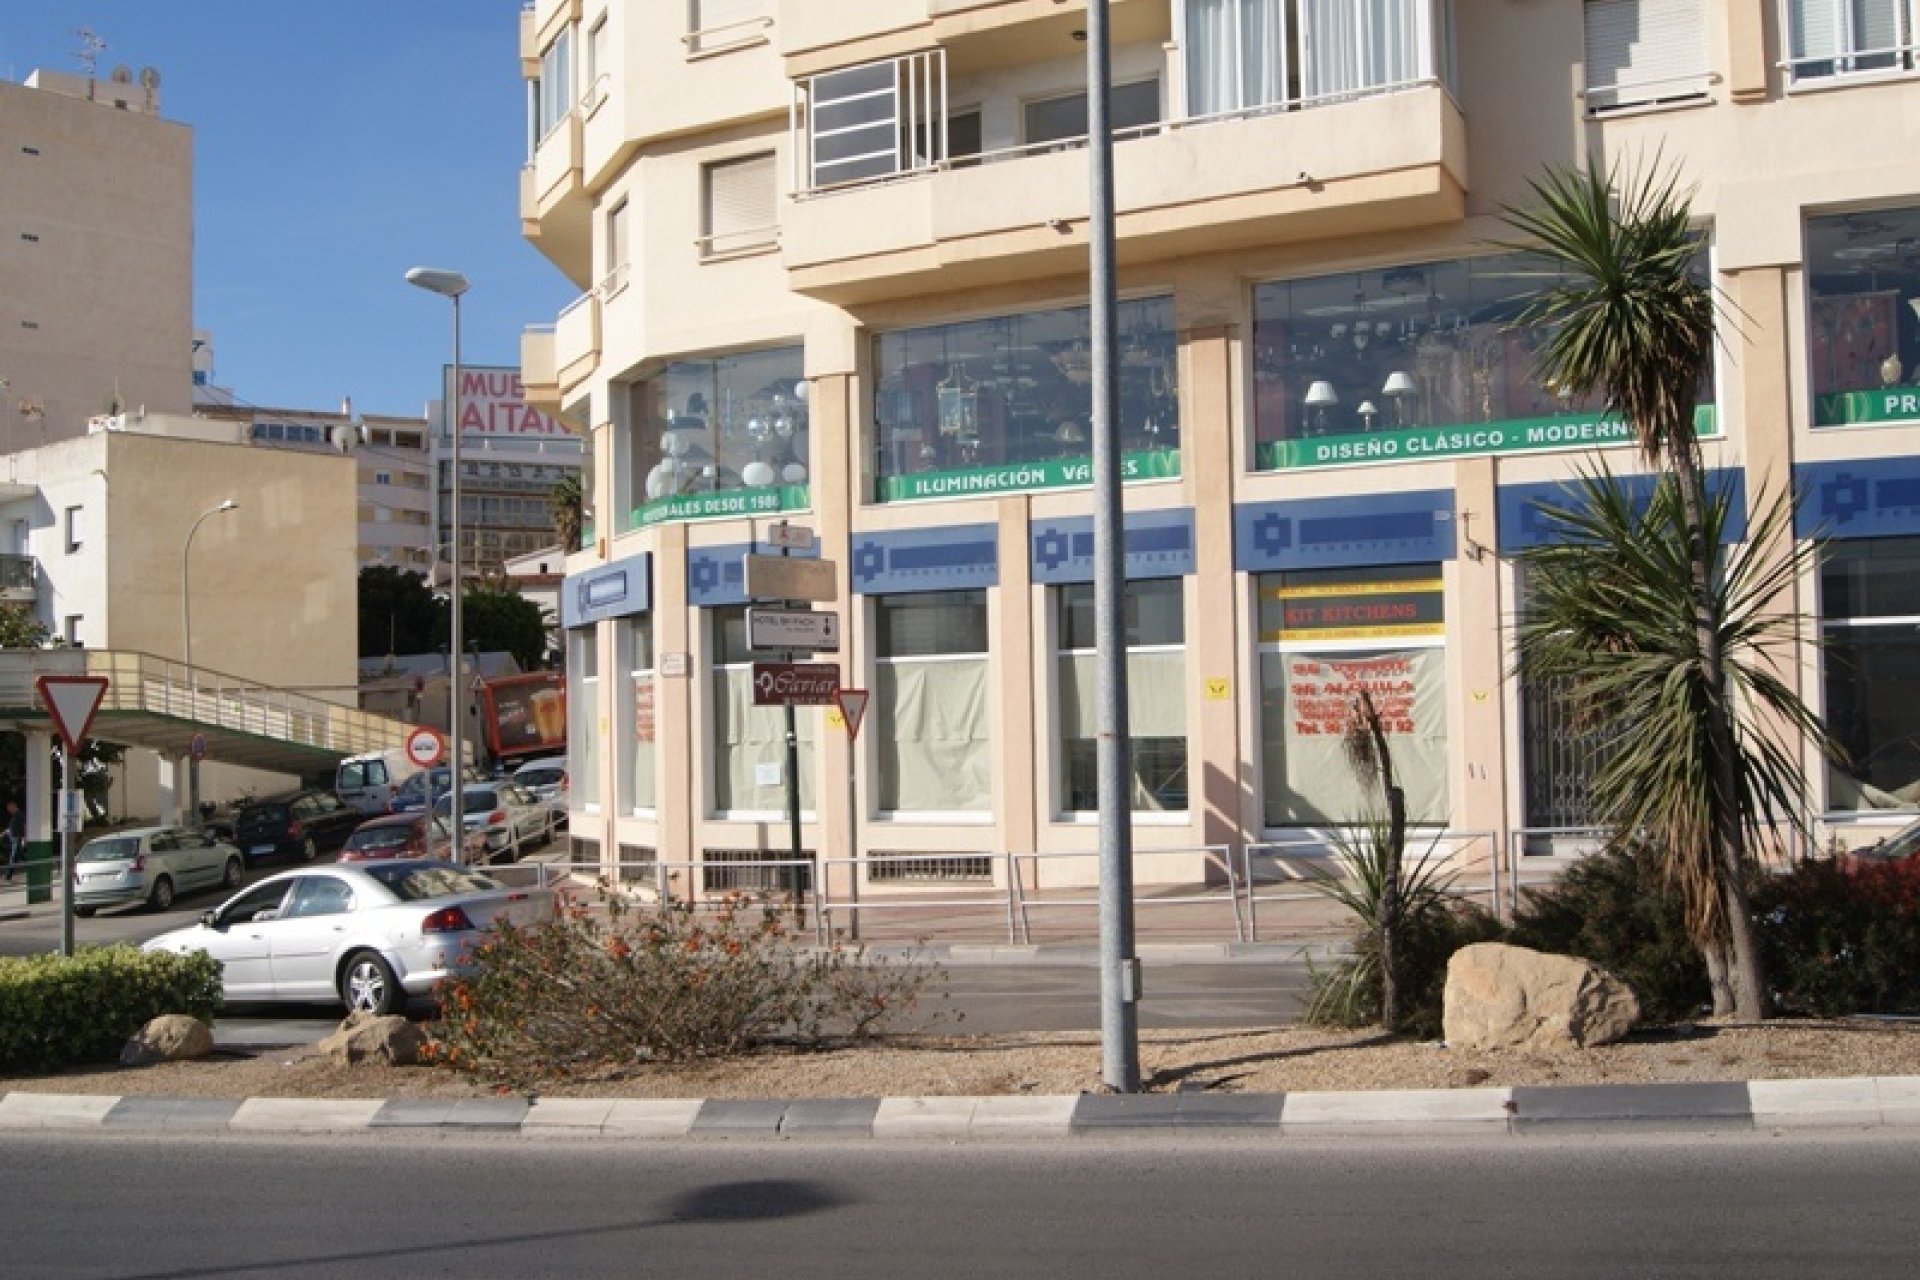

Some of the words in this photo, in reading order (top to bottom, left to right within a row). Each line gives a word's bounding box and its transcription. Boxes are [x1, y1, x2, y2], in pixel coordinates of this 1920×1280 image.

[1884, 394, 1920, 414] PR
[1316, 438, 1398, 460] DISEÑO
[1405, 431, 1504, 453] CLÁSICO
[1527, 421, 1637, 443] MODERN
[915, 464, 1045, 495] ILUMINACIÓN
[1062, 459, 1139, 480] VAES
[705, 498, 745, 513] DESDE
[1285, 608, 1315, 624] KIT
[1321, 603, 1418, 622] KITCHENS
